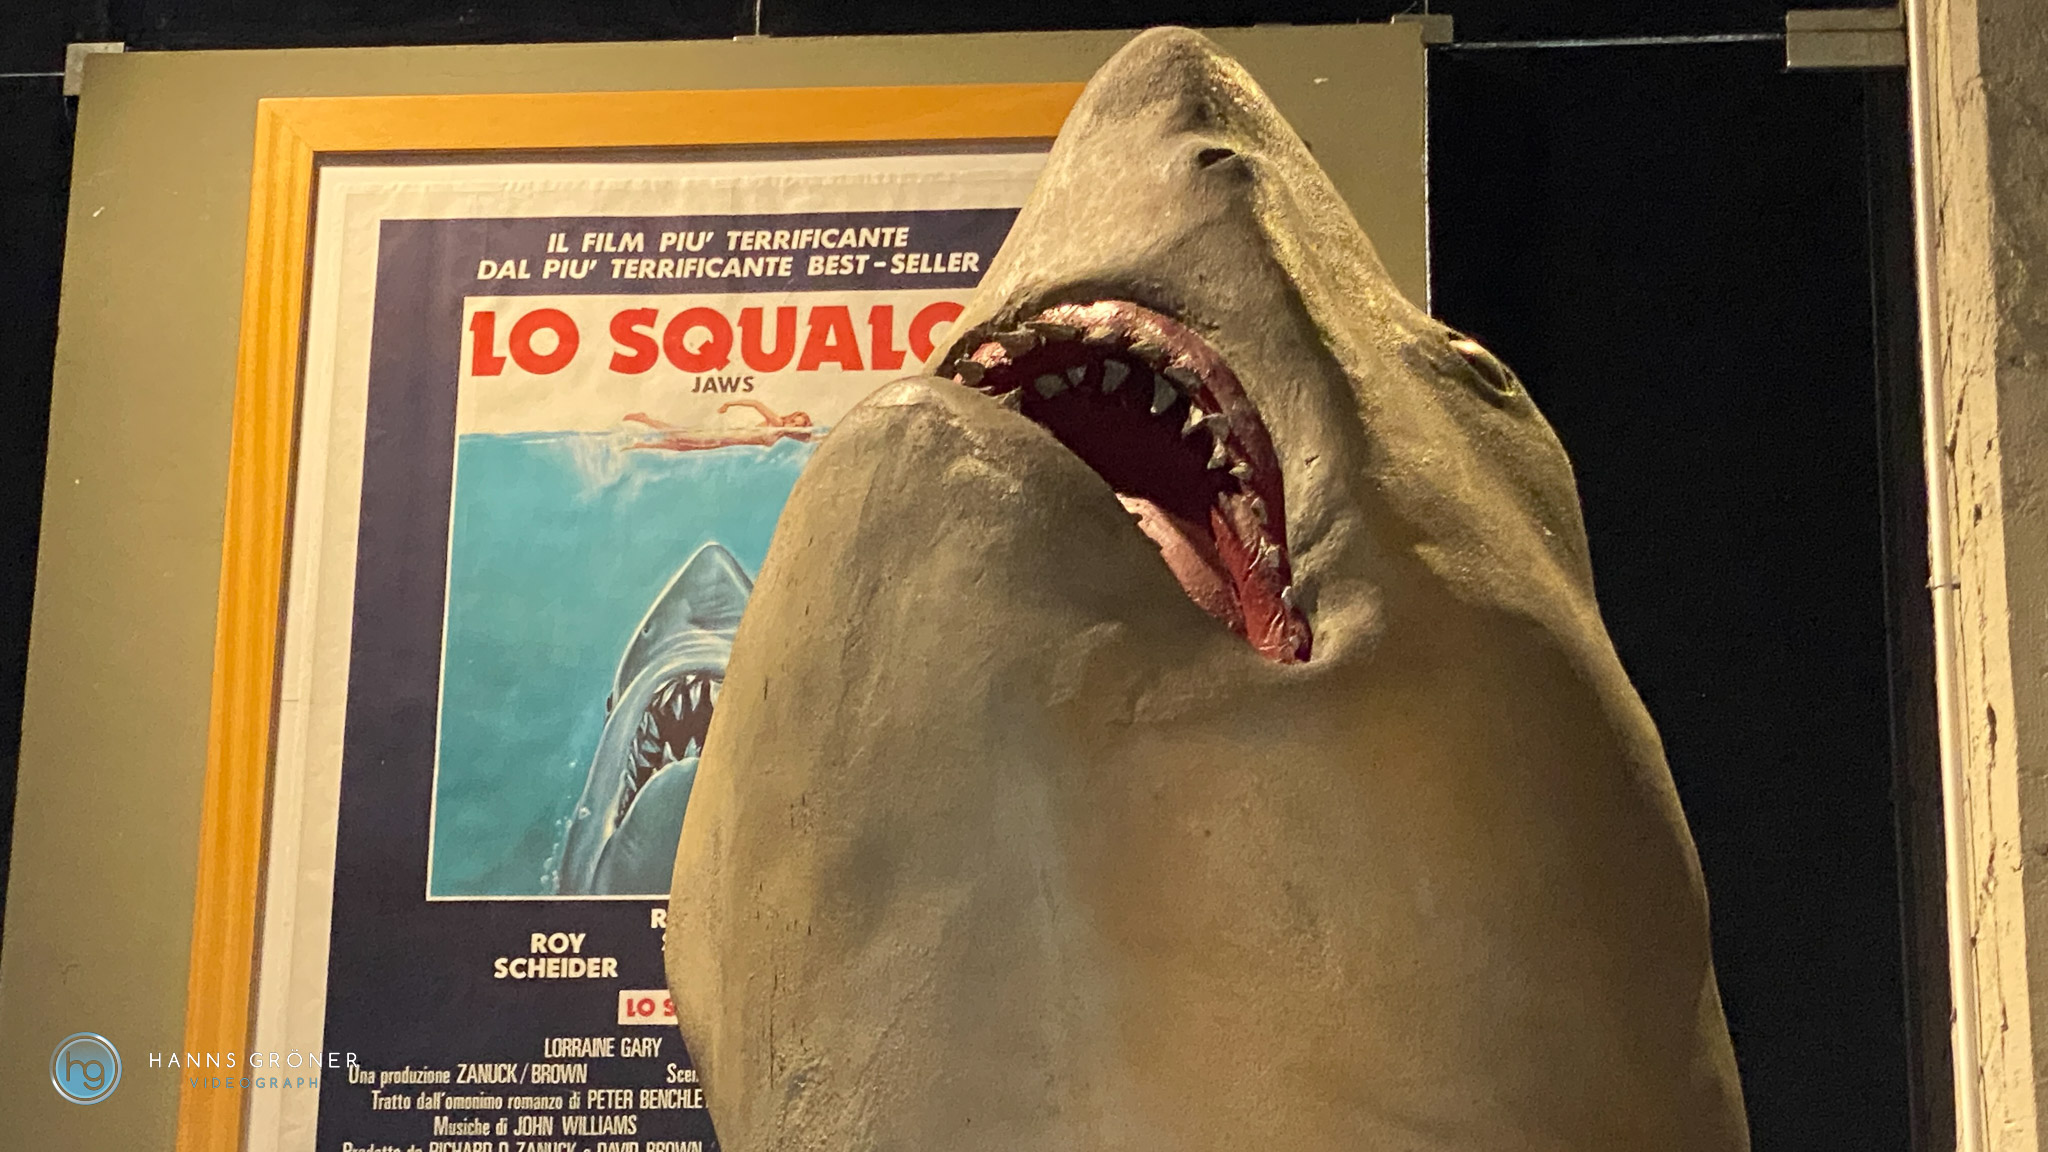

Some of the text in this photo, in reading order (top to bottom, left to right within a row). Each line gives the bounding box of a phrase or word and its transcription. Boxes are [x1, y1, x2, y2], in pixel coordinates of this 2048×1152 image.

[547, 227, 909, 253] IL FILM PIU' TERRIFICANTE
[477, 258, 531, 280] DAL
[541, 257, 597, 279] PIU'
[610, 255, 792, 278] TERRIFICANTE
[469, 308, 580, 377] LO
[692, 376, 755, 393] JAWS
[531, 933, 586, 954] ROY
[494, 957, 618, 979] SCHEIDER
[627, 999, 677, 1017] LO S
[545, 1037, 662, 1057] LORRAINE GARY
[349, 1064, 375, 1084] Una
[380, 1066, 450, 1088] produzione
[371, 1088, 709, 1110] Tratto dall'omonimo romanzo di PETER BENCHLE
[433, 1114, 637, 1136] Musiche di JOHN WILLIAMS
